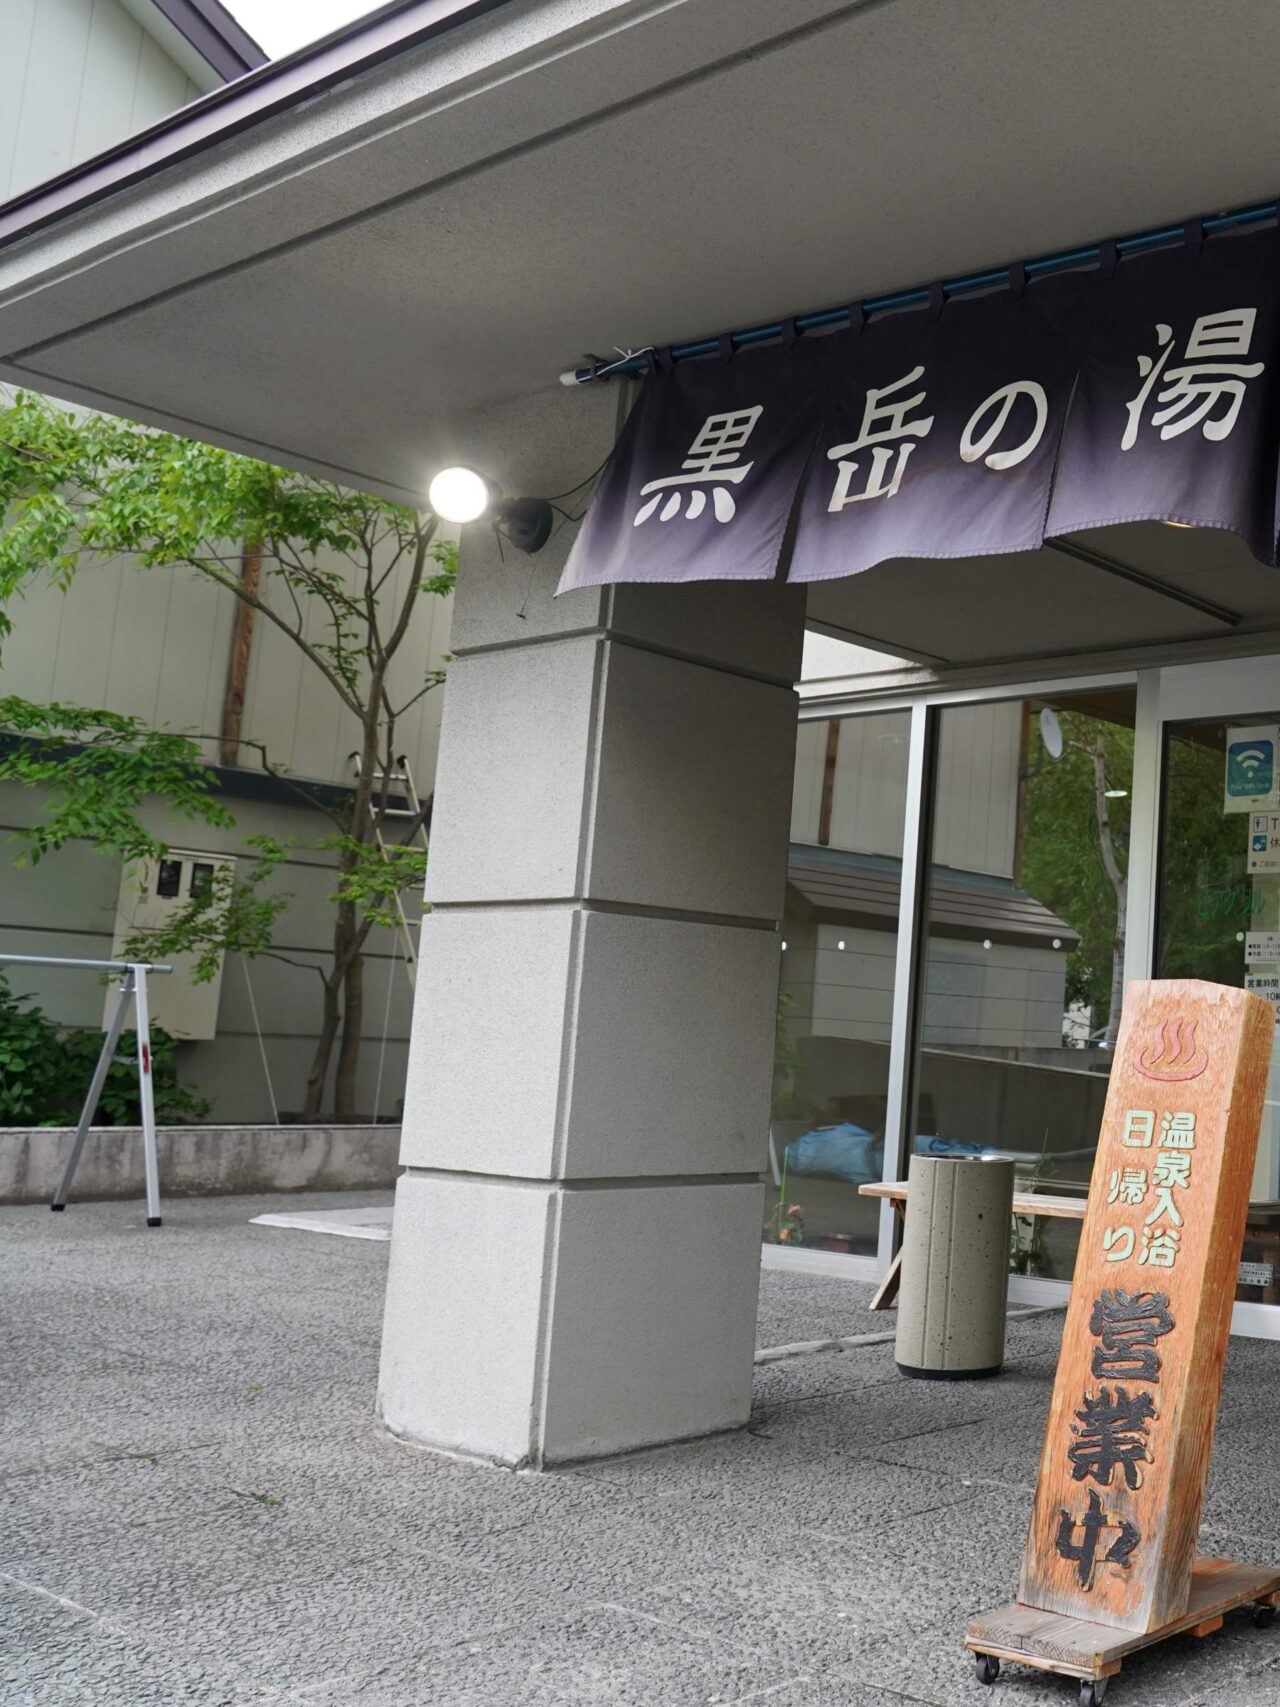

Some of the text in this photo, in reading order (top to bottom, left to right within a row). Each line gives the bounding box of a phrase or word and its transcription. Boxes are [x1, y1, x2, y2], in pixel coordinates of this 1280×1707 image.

[632, 307, 1266, 527] 黒岳の湯
[1247, 979, 1279, 988] 営業時間
[1102, 1109, 1157, 1263] 日帰り
[1137, 1110, 1198, 1268] 温泉入浴
[1055, 1286, 1175, 1593] 営業中
